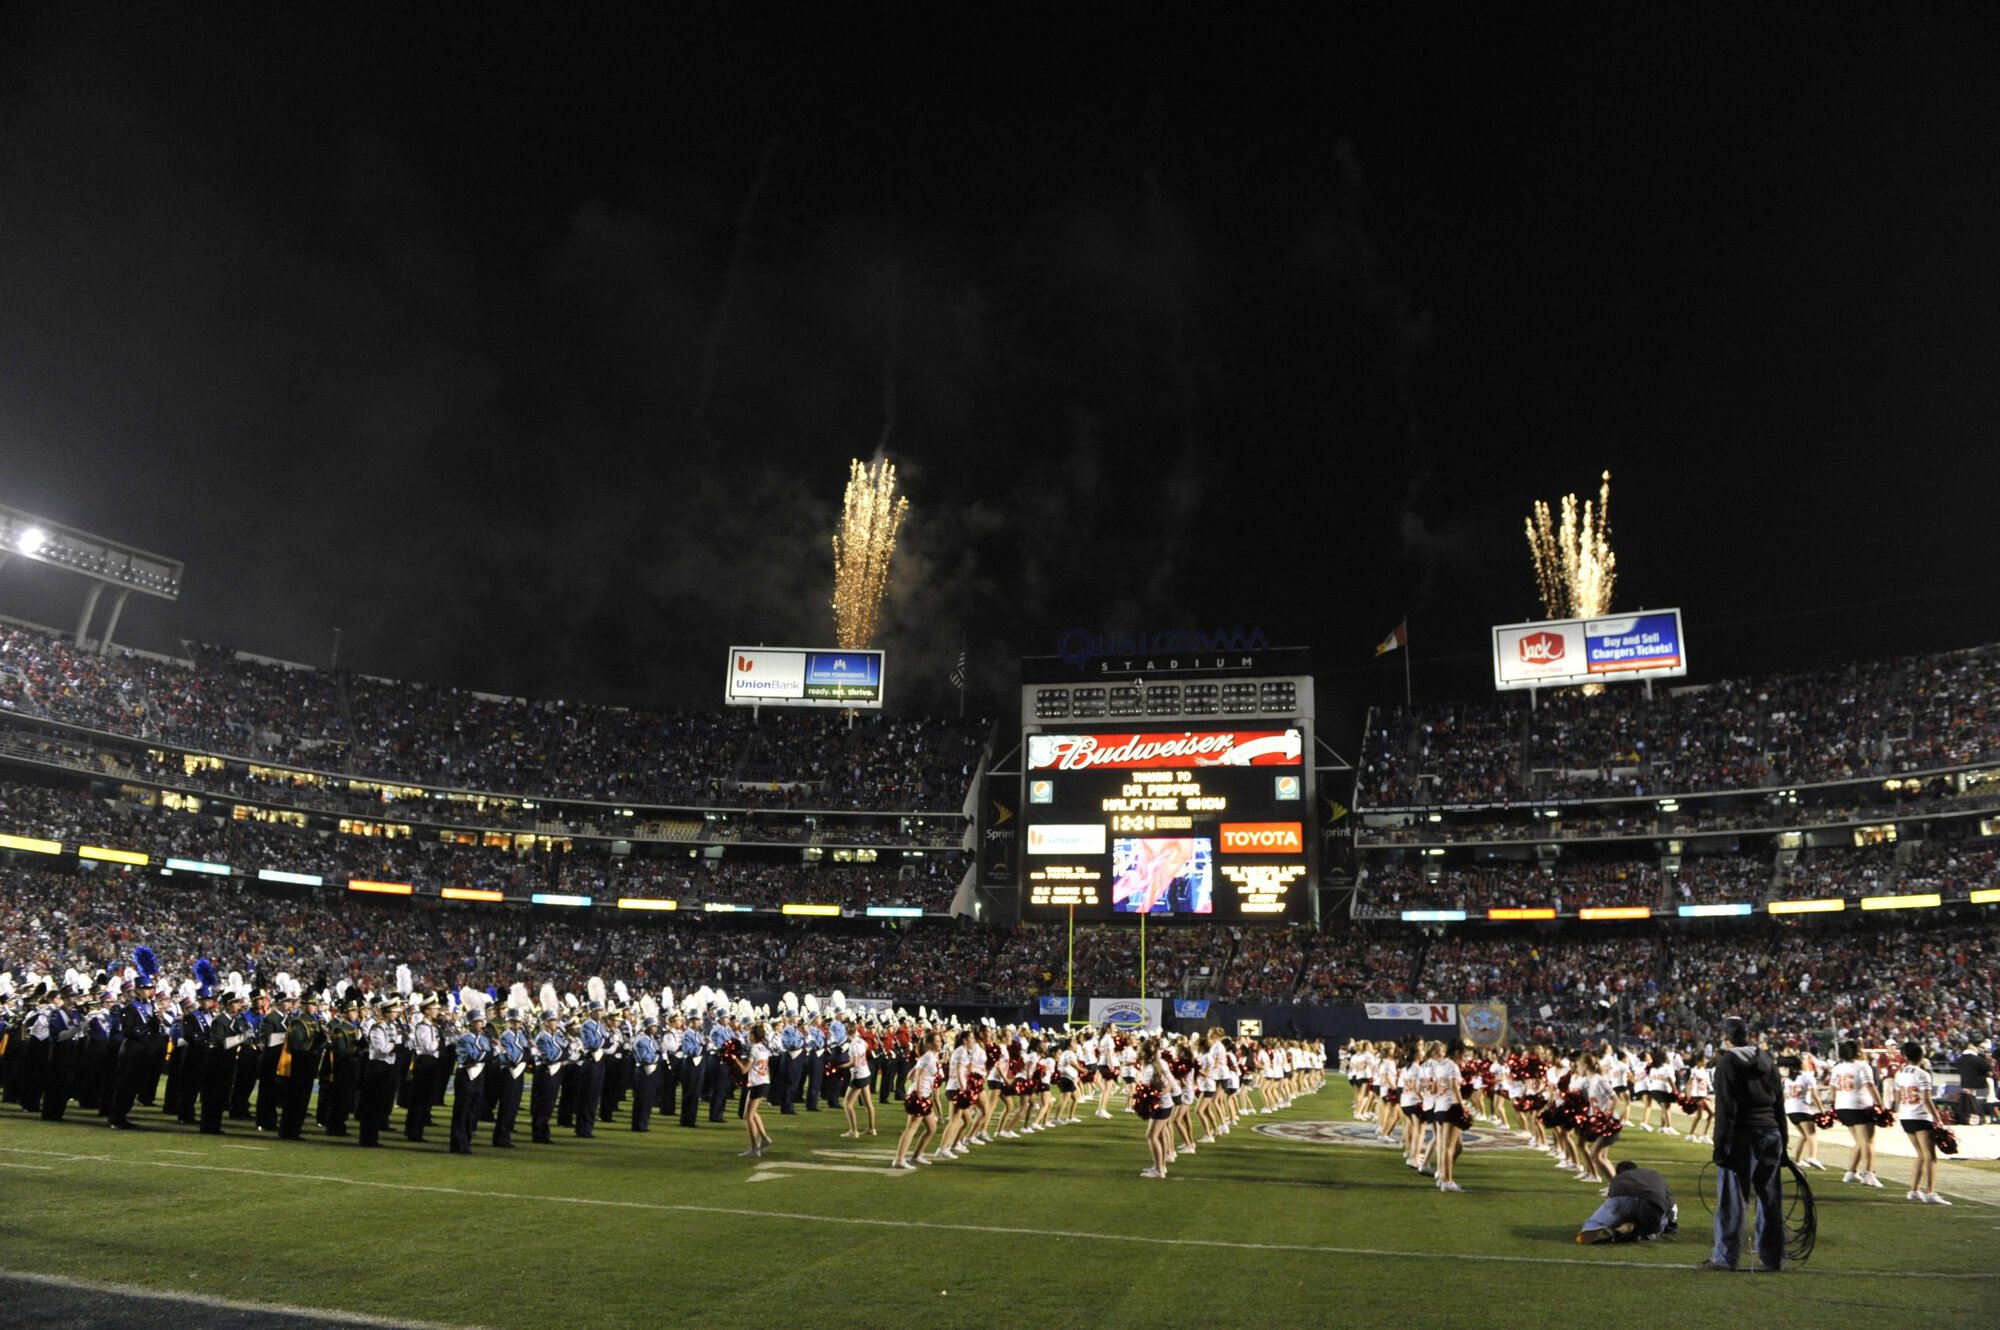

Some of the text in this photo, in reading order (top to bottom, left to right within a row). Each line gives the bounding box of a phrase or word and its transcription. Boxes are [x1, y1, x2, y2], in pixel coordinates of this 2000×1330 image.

[1603, 632, 1660, 648] Buy and Sell
[1057, 627, 1270, 671] QUALCOMM
[1521, 634, 1564, 662] Jack
[1592, 643, 1673, 660] Chargers Tickets!
[1101, 657, 1252, 671] STADIUM
[736, 679, 800, 690] UnionBank
[808, 688, 831, 696] ready.
[847, 688, 874, 696] thrive.
[1056, 732, 1234, 769] Budweiser
[1176, 771, 1192, 782] TO
[1122, 783, 1201, 797] DR PEPPER
[1185, 797, 1226, 810] SHOW
[986, 828, 1015, 840] Sprint
[1224, 831, 1299, 847] TOYOTA
[1107, 1003, 1131, 1014] PACIFIC
[1430, 1006, 1448, 1022] N
